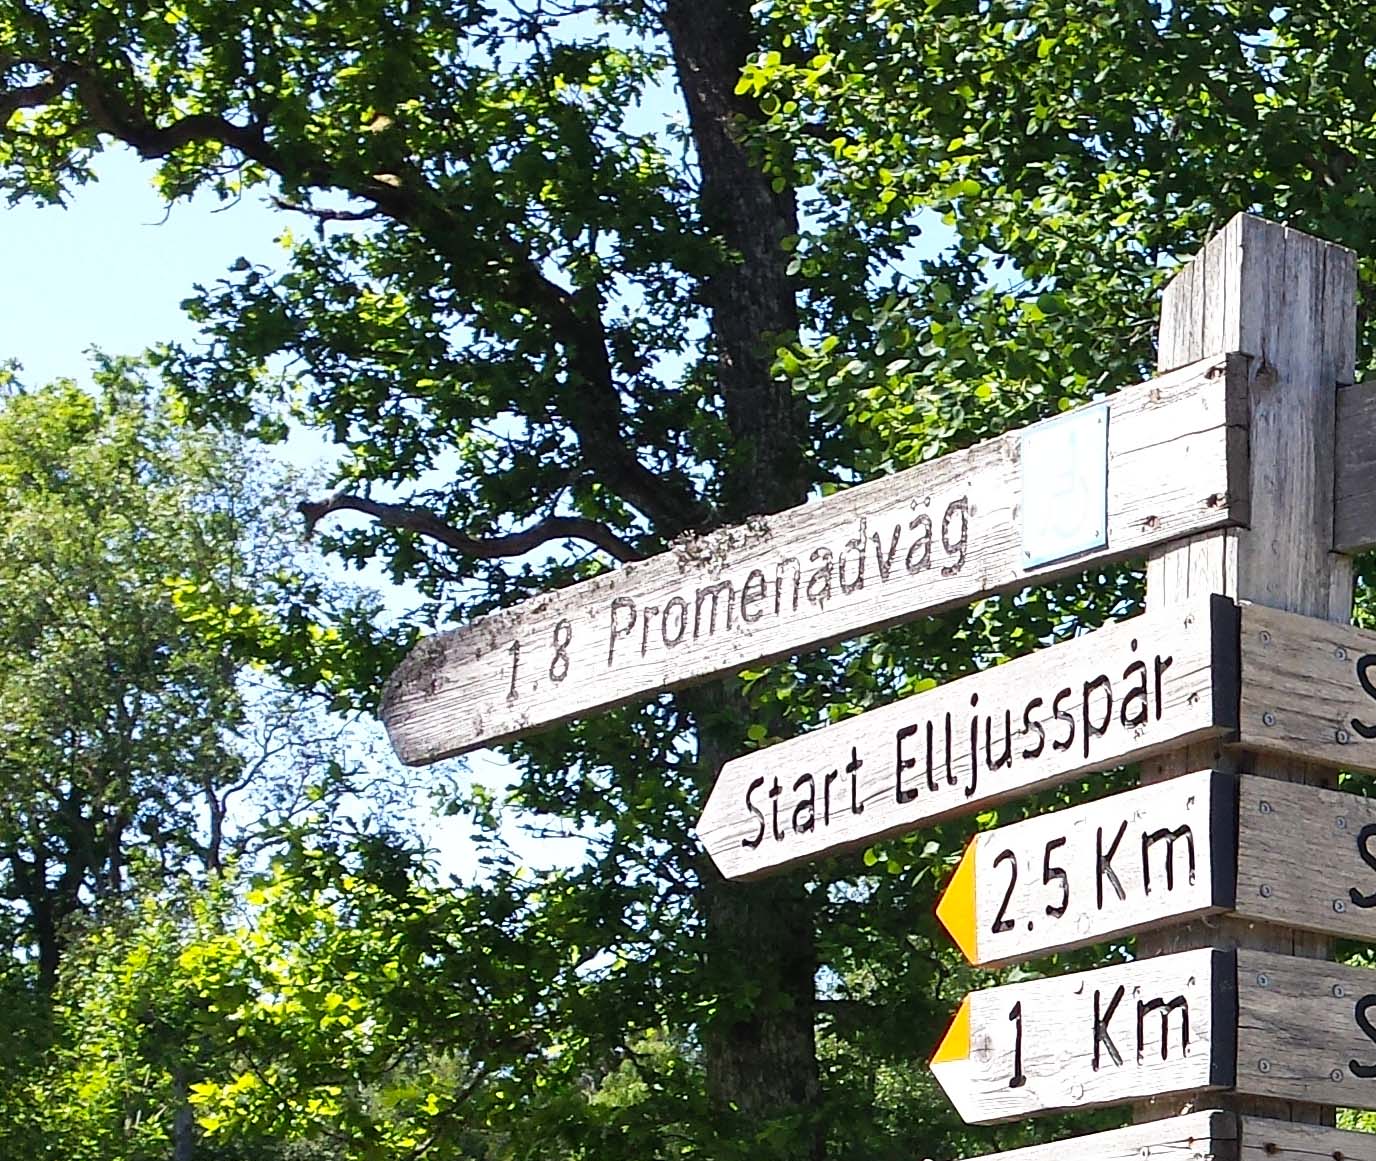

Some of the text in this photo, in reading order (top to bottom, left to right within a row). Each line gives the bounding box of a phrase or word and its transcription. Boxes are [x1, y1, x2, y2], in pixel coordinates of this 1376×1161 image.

[608, 494, 971, 667] Promenadväg
[741, 638, 1173, 849] Start Elljusspår
[991, 819, 1196, 934] 2.5 Km
[1008, 984, 1191, 1089] 1 Km
